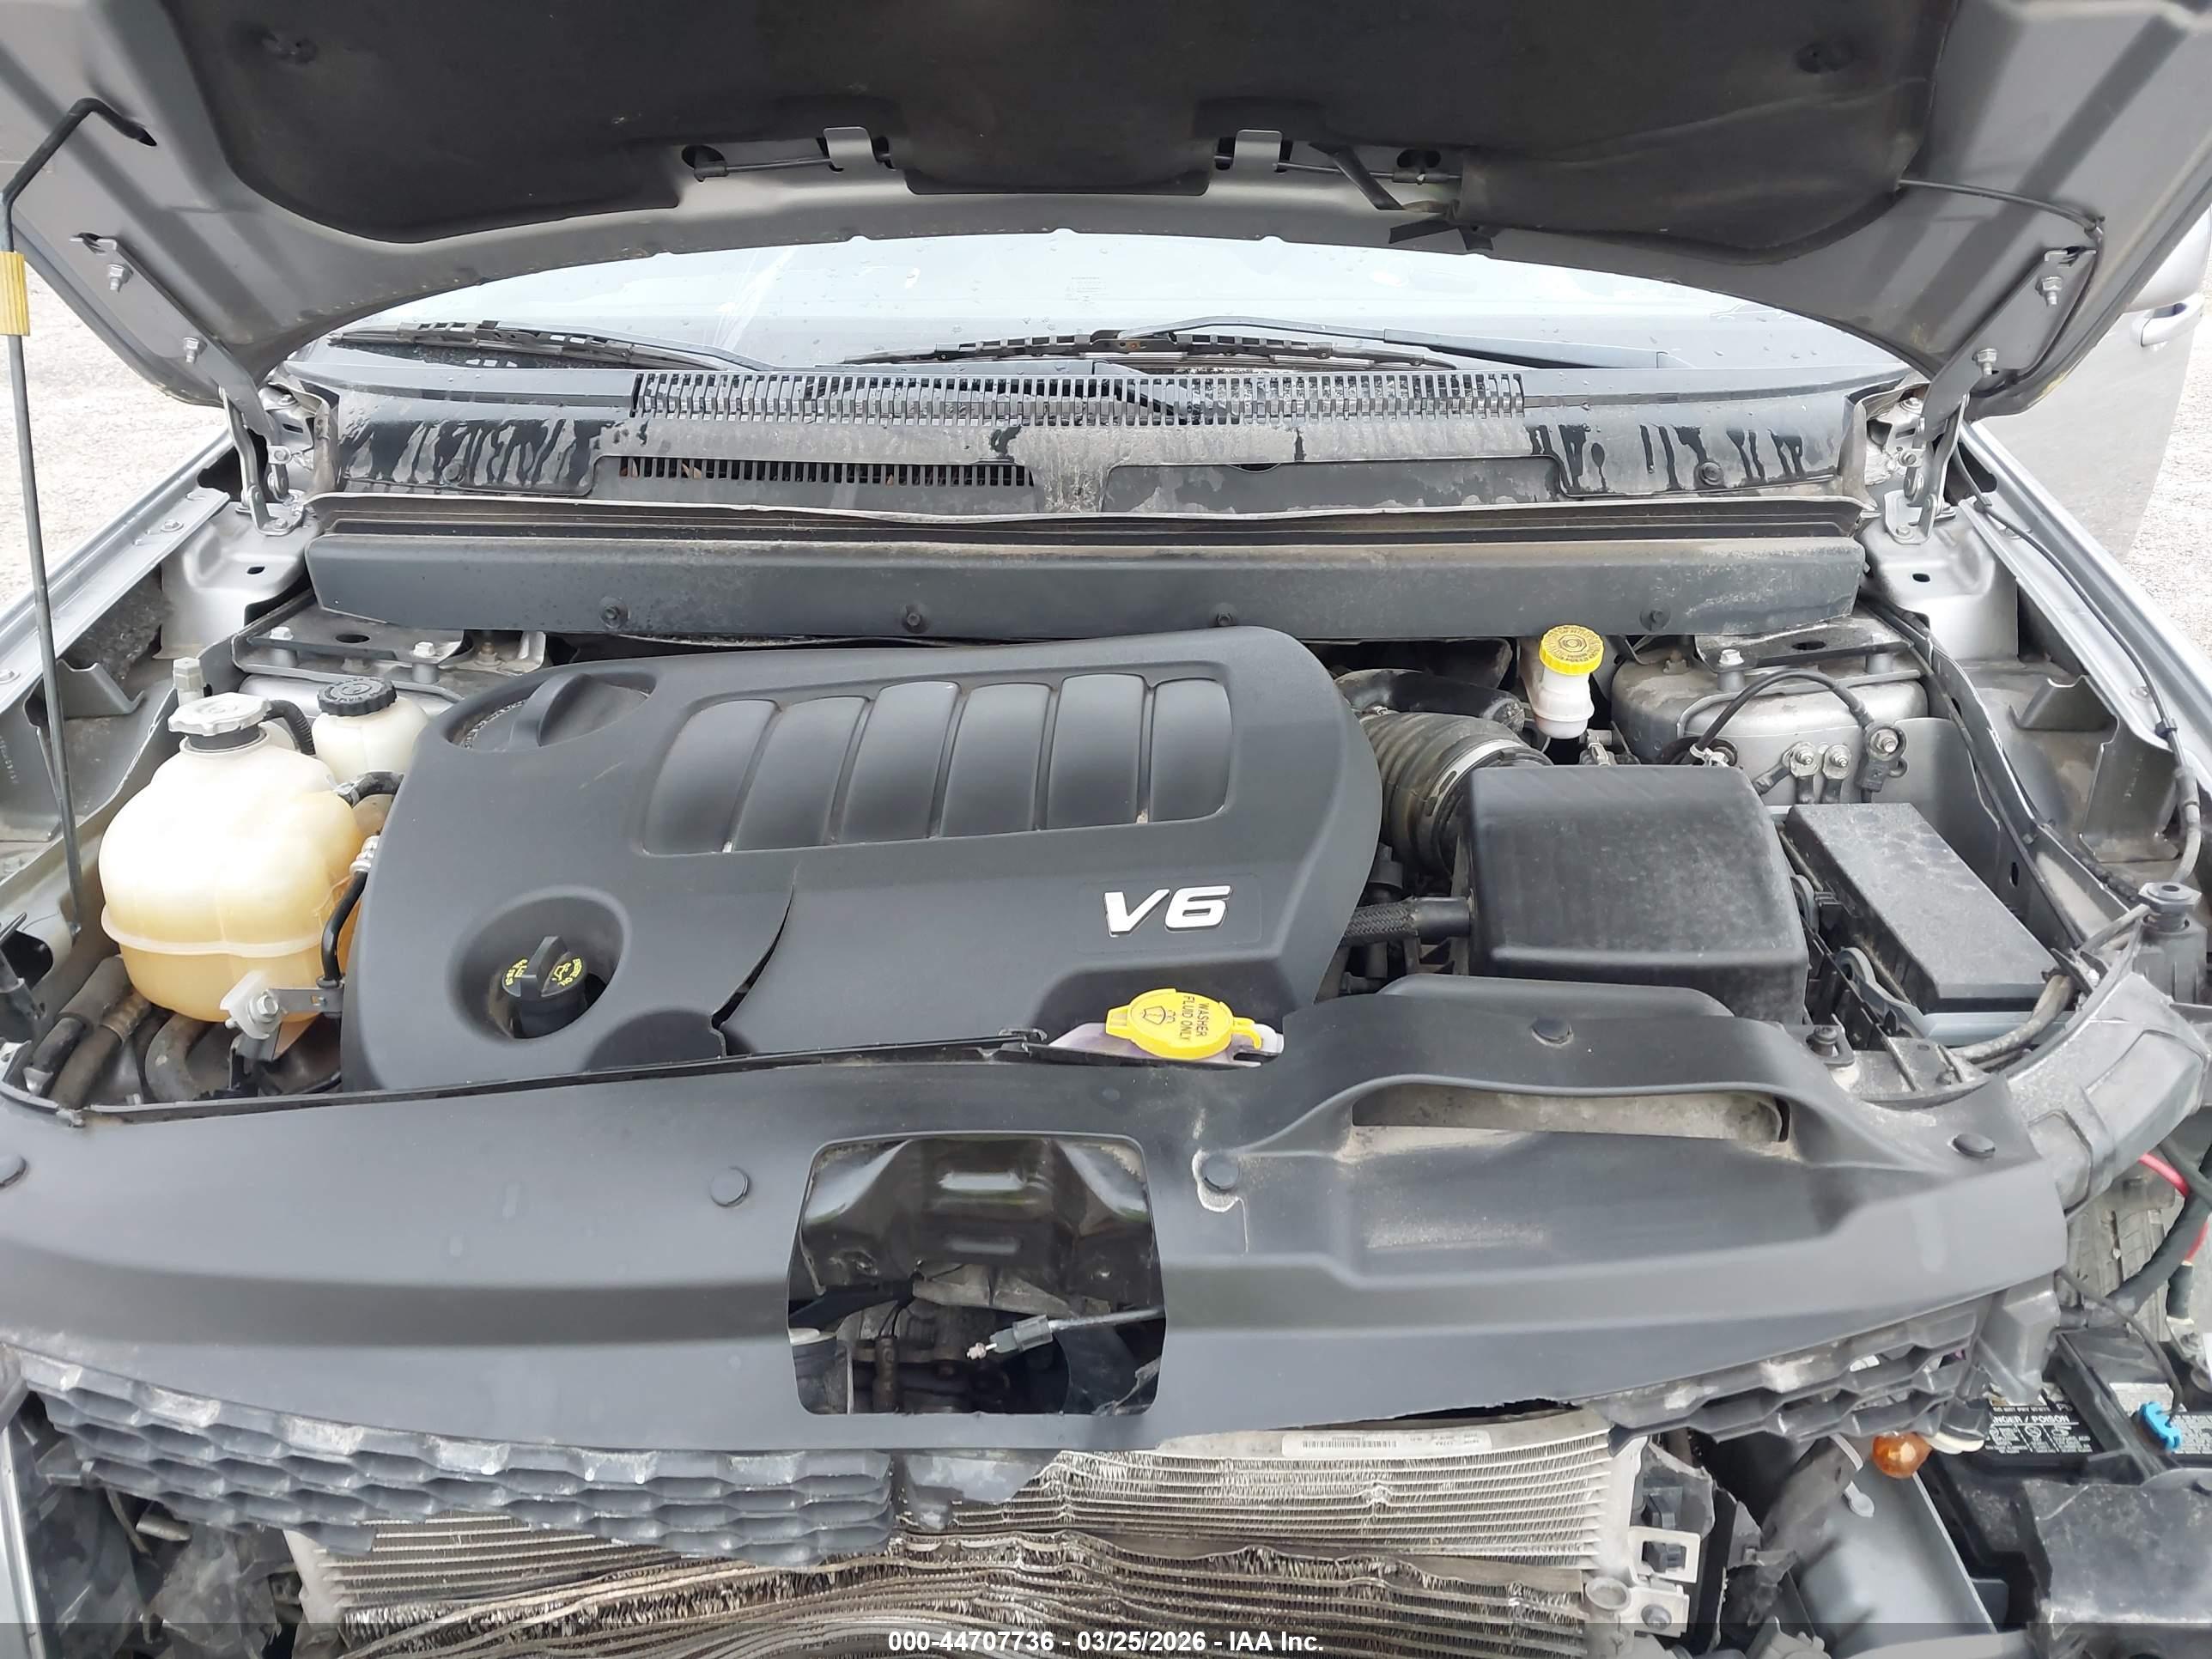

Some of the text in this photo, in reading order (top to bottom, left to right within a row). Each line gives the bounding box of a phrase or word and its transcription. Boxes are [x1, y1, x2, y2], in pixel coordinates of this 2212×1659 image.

[1104, 885, 1231, 935] V6
[1179, 996, 1195, 1042] FLUID ONLY
[1197, 1002, 1210, 1037] WASHER
[2031, 1414, 2070, 1423] POISON
